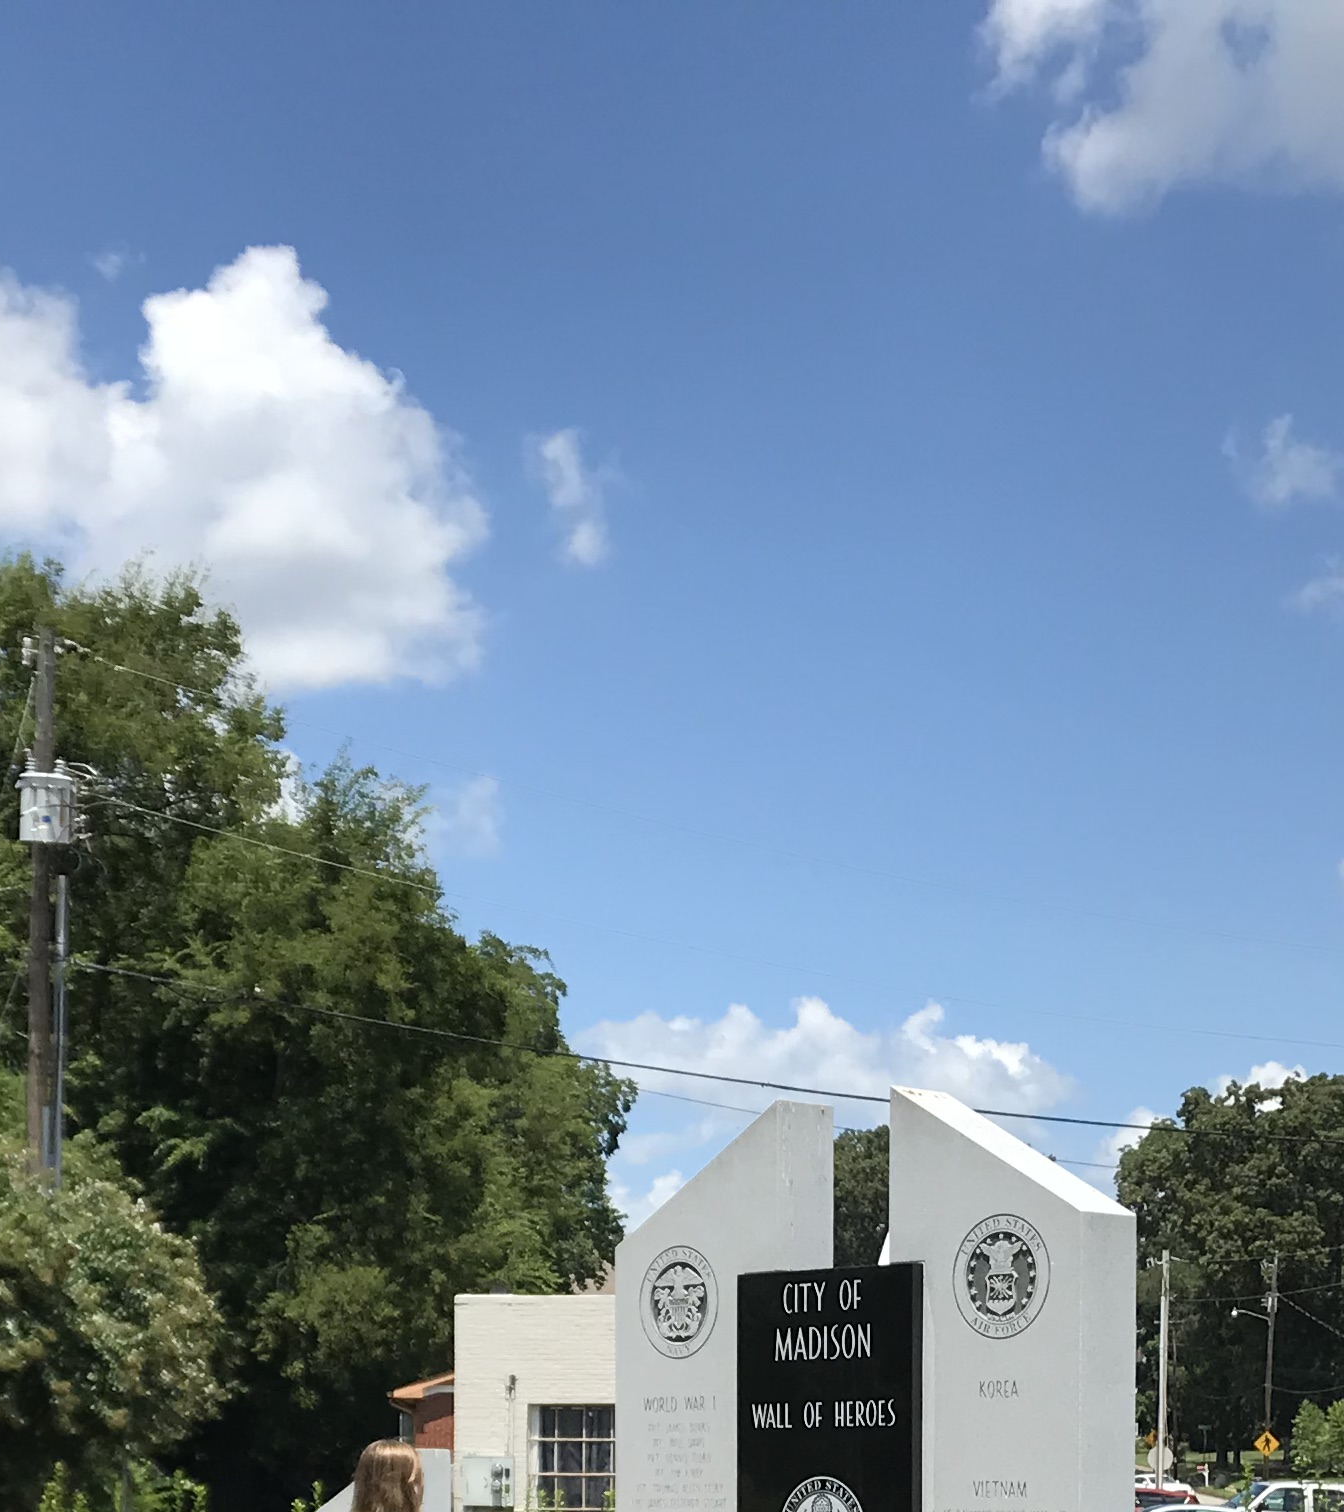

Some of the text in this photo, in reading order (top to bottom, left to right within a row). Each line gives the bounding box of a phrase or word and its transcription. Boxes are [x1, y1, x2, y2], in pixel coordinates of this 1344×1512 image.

[960, 1217, 1043, 1256] UNITED STATES
[782, 1279, 861, 1315] CITY OF
[969, 1311, 1032, 1336] AIR FORCE
[774, 1323, 871, 1362] MADISON
[978, 1379, 1019, 1399] KOREA
[642, 1396, 678, 1413] WORLD
[684, 1395, 705, 1411] WAR
[751, 1399, 896, 1429] WALL OF HEROES
[972, 1480, 1028, 1499] VIETNAM
